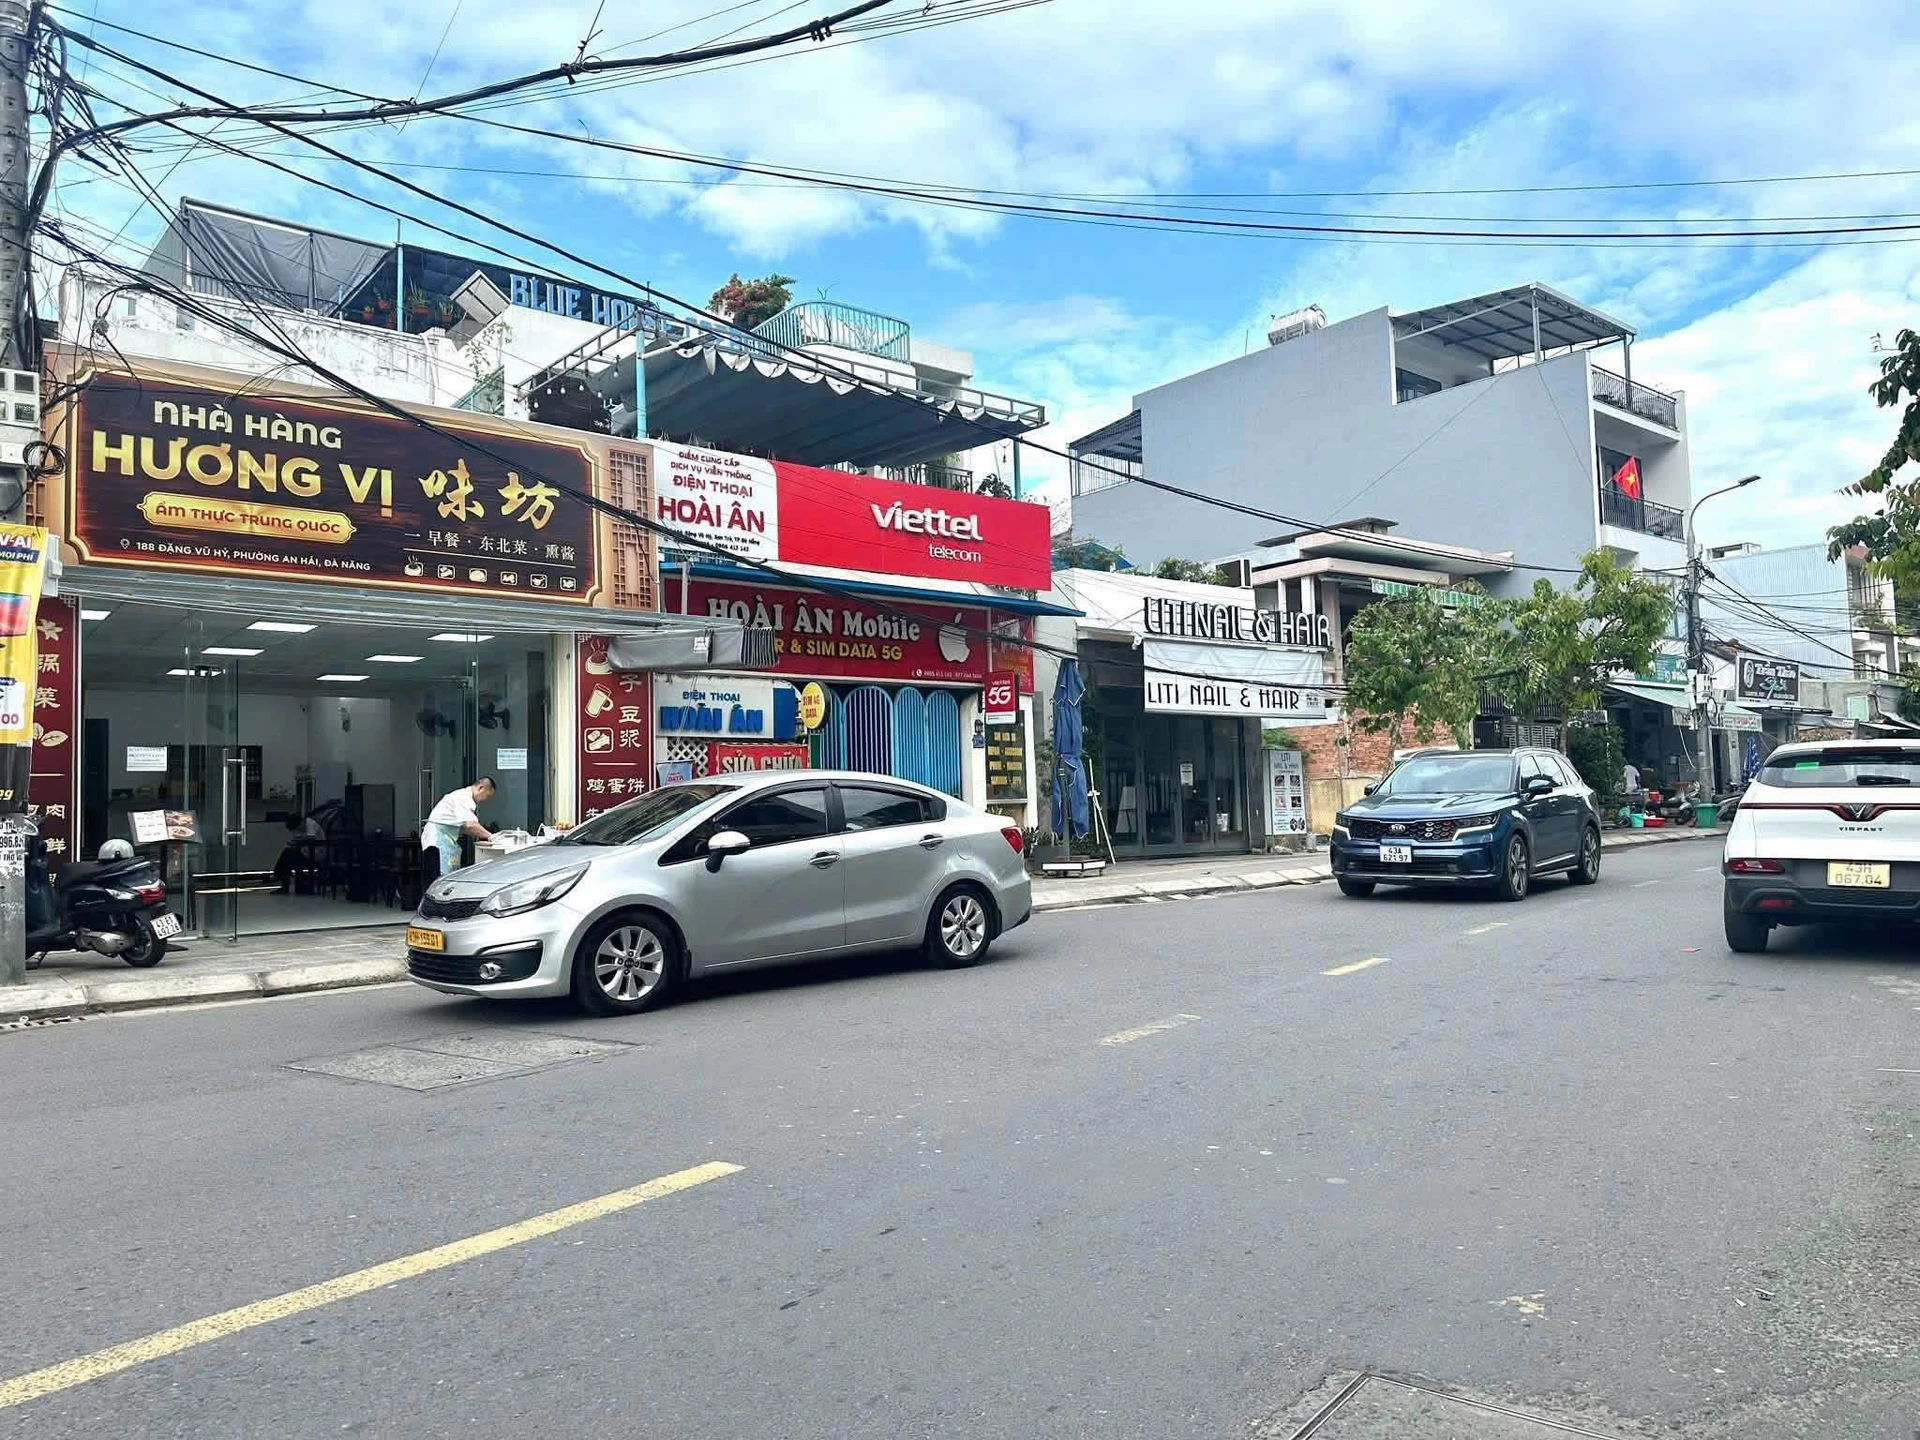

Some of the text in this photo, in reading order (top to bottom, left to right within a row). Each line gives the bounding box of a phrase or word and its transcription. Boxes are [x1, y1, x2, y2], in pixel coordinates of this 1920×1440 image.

[509, 273, 582, 319] BLUE
[154, 400, 342, 449] NHÀ HÀNG
[701, 455, 721, 465] CUNG
[92, 430, 393, 519] HƯƠNG VỊ
[673, 474, 753, 498] ĐIỆN THOẠI
[725, 470, 751, 481] THÔNG
[418, 458, 560, 530] 味坊
[190, 508, 235, 526] THỰC
[239, 513, 292, 529] TRUNG
[296, 518, 340, 534] QUỐC
[658, 495, 765, 533] HOÀI ÂN
[870, 501, 983, 541] viettel
[136, 541, 155, 551] 188
[158, 542, 192, 556] ĐẶNG
[195, 545, 211, 556] VŨ
[233, 549, 279, 563] PHƯỜNG
[282, 555, 299, 565] AN
[323, 558, 339, 568] ĐÀ
[928, 543, 982, 563] telecom
[793, 597, 834, 635] ÂN
[842, 610, 921, 642] Mobile
[1252, 609, 1272, 643] &
[1274, 610, 1333, 647] HAIR
[790, 638, 802, 654] &
[806, 640, 836, 656] SIM
[838, 642, 877, 659] DATA
[881, 645, 903, 661] 5G
[682, 689, 741, 704] ĐIỆN THOẠI
[988, 686, 1012, 705] 5G
[1147, 682, 1180, 705] LITI
[1190, 684, 1231, 707] NAIL
[1240, 687, 1251, 708] &
[1258, 689, 1299, 710] HAIR
[659, 702, 764, 734] HOÀI ÂN
[721, 750, 756, 773] SỬA
[586, 777, 645, 795] 鸡蛋饼
[1835, 873, 1882, 885] 067.04
[1846, 862, 1872, 874] 43H
